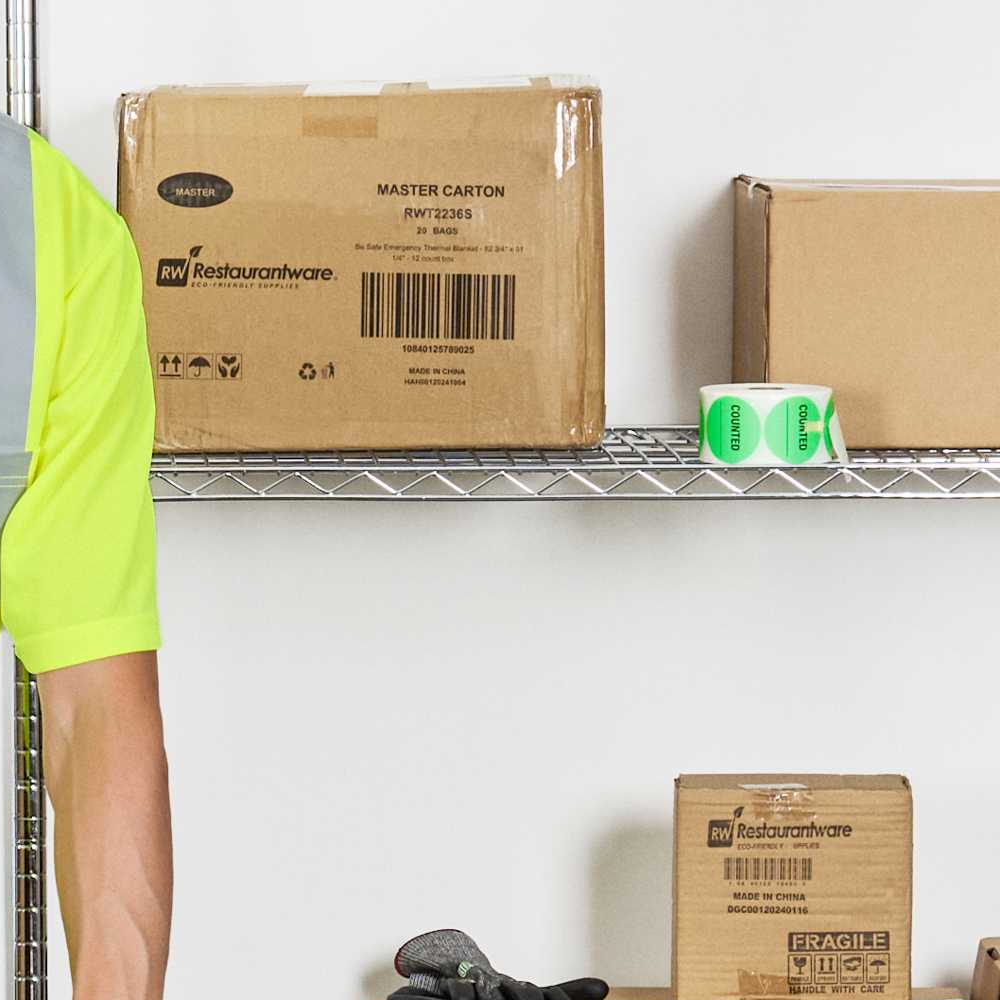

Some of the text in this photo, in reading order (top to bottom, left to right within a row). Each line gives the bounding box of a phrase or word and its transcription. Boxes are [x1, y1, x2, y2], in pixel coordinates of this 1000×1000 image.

[175, 188, 216, 197] MASTER
[377, 184, 506, 198] MASTER CARTON
[404, 207, 473, 220] RWT2236S
[416, 226, 459, 235] 20 BAGS
[161, 265, 186, 280] RW
[192, 262, 334, 281] Restaurantware
[408, 367, 465, 375] MADE IN CHINA
[730, 404, 741, 451] COUNTED
[711, 826, 732, 841] RW
[737, 821, 853, 839] Restaurantware
[733, 892, 806, 901] MADE IN CHINA
[792, 933, 887, 950] FRAGILE
[789, 985, 885, 994] HANDLE WITH CARE
